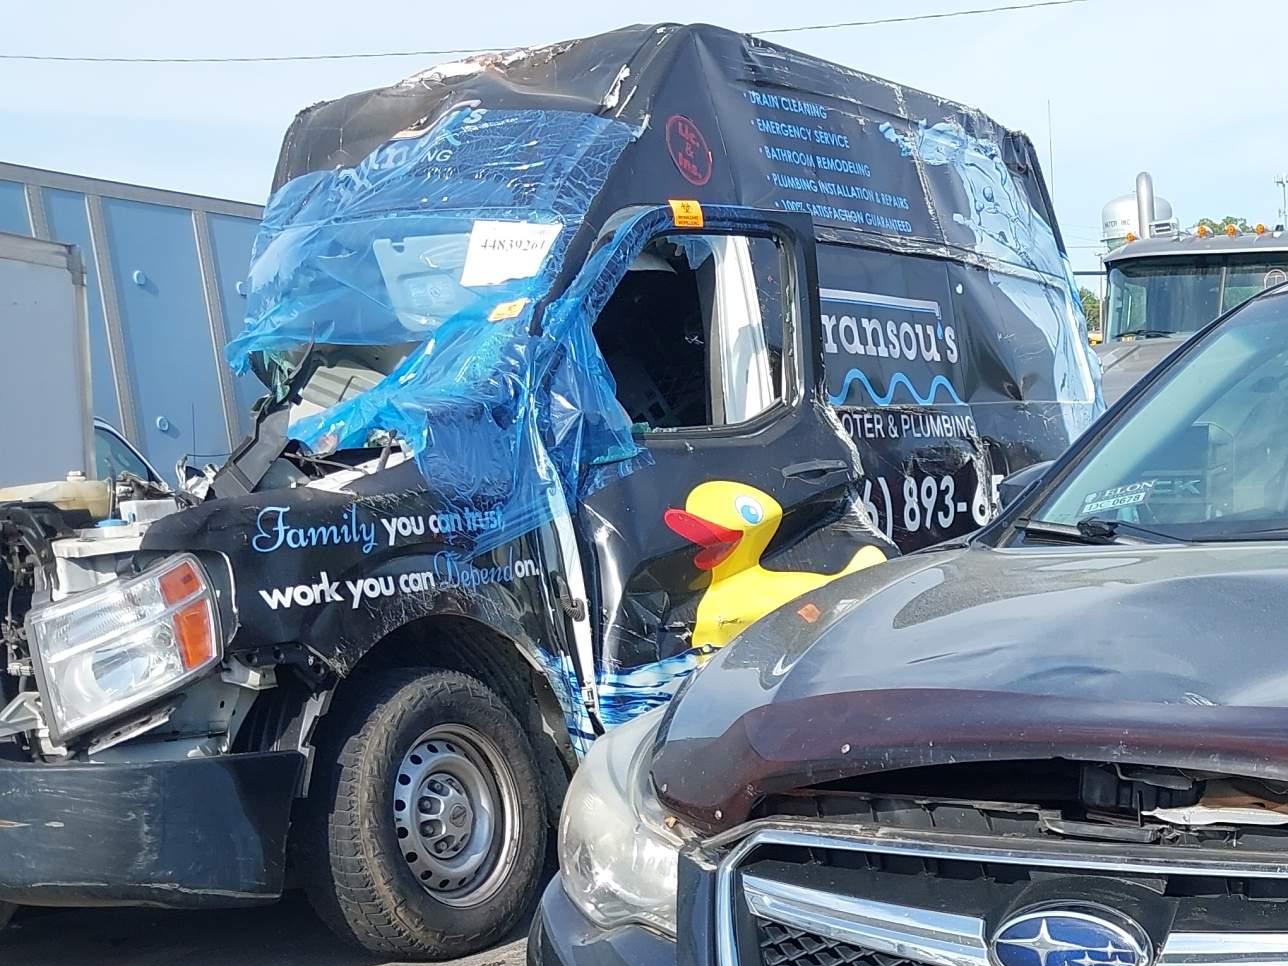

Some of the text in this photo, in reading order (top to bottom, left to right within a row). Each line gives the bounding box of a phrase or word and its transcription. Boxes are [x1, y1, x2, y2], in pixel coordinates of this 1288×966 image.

[750, 90, 828, 119] DRAIN CLEANING
[757, 118, 850, 149] EMERGENCY SERVICE
[764, 145, 871, 177] BATHROOM REMODELING
[772, 172, 818, 192] PLUMBING
[818, 180, 874, 201] INSTALLATION
[881, 191, 909, 210] REPAIRS
[807, 203, 864, 224] SATISFACTION
[865, 213, 912, 233] GUARANTEED
[822, 314, 958, 363] ransou's
[841, 413, 976, 439] OTER & PLUMBING
[252, 504, 378, 553] Family
[381, 515, 423, 545] you
[429, 511, 463, 534] can
[259, 546, 540, 610] work you can Depend on.
